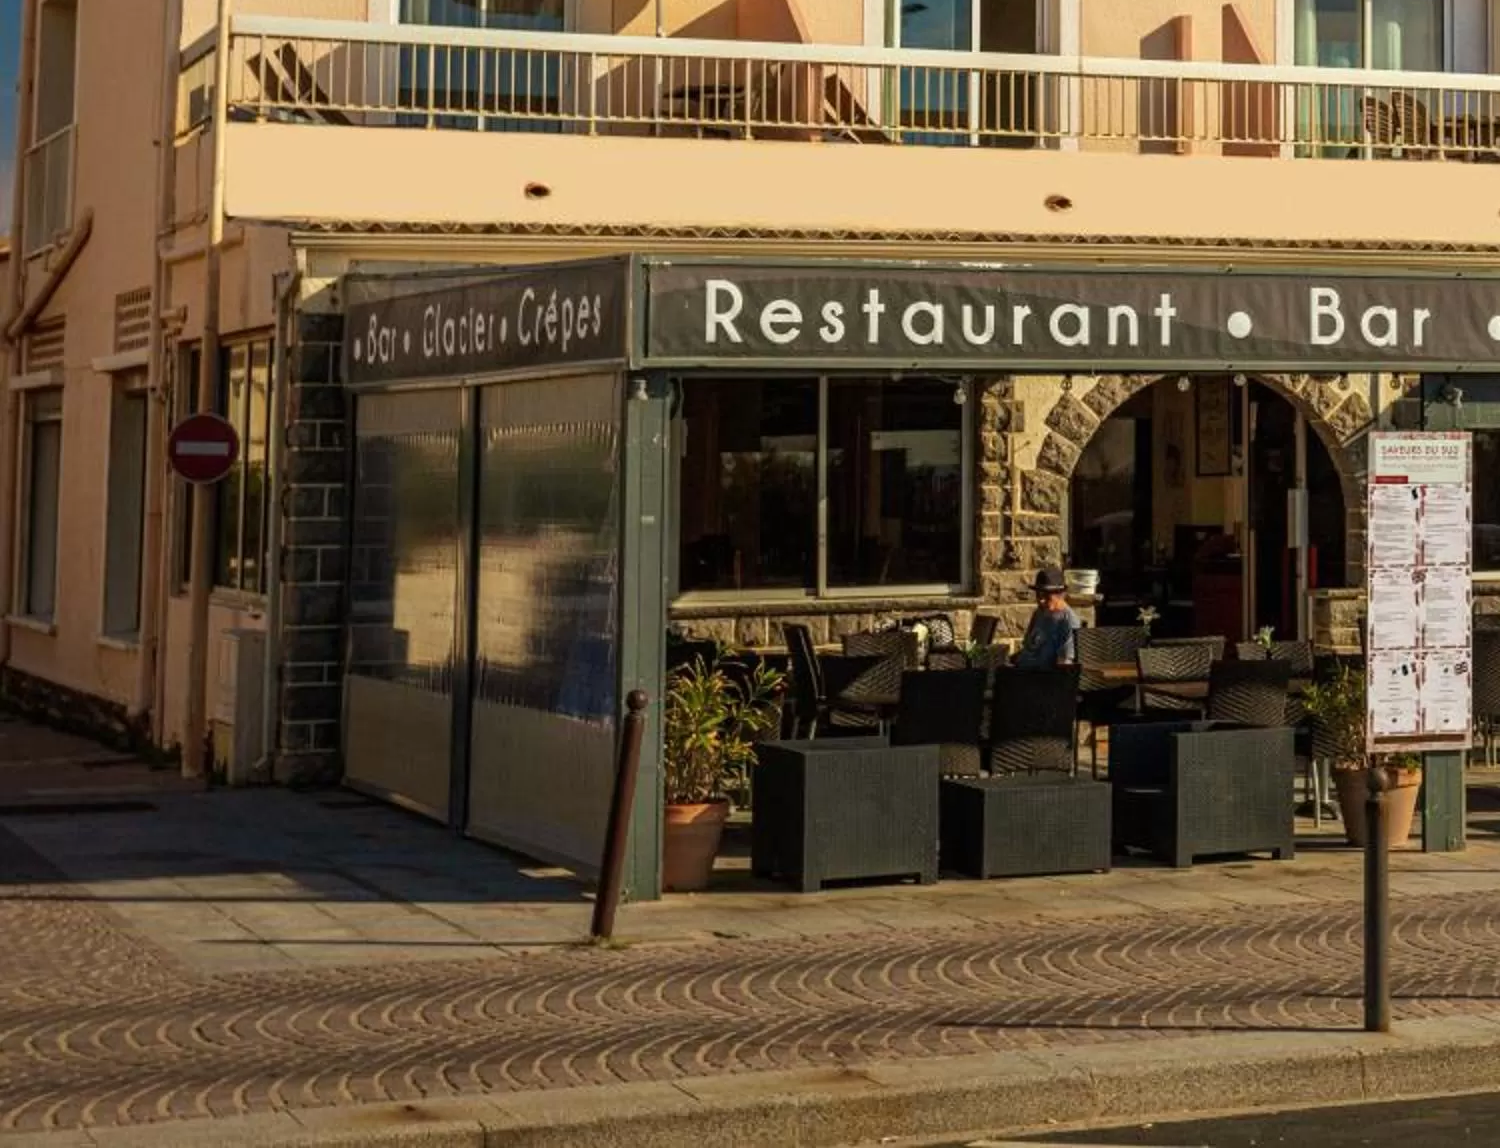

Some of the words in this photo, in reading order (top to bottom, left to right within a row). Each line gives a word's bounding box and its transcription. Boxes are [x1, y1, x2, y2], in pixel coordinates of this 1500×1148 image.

[366, 312, 397, 364] Bar
[422, 304, 494, 357] Glacier
[704, 279, 1178, 347] Restaurant
[1309, 287, 1432, 348] Bar
